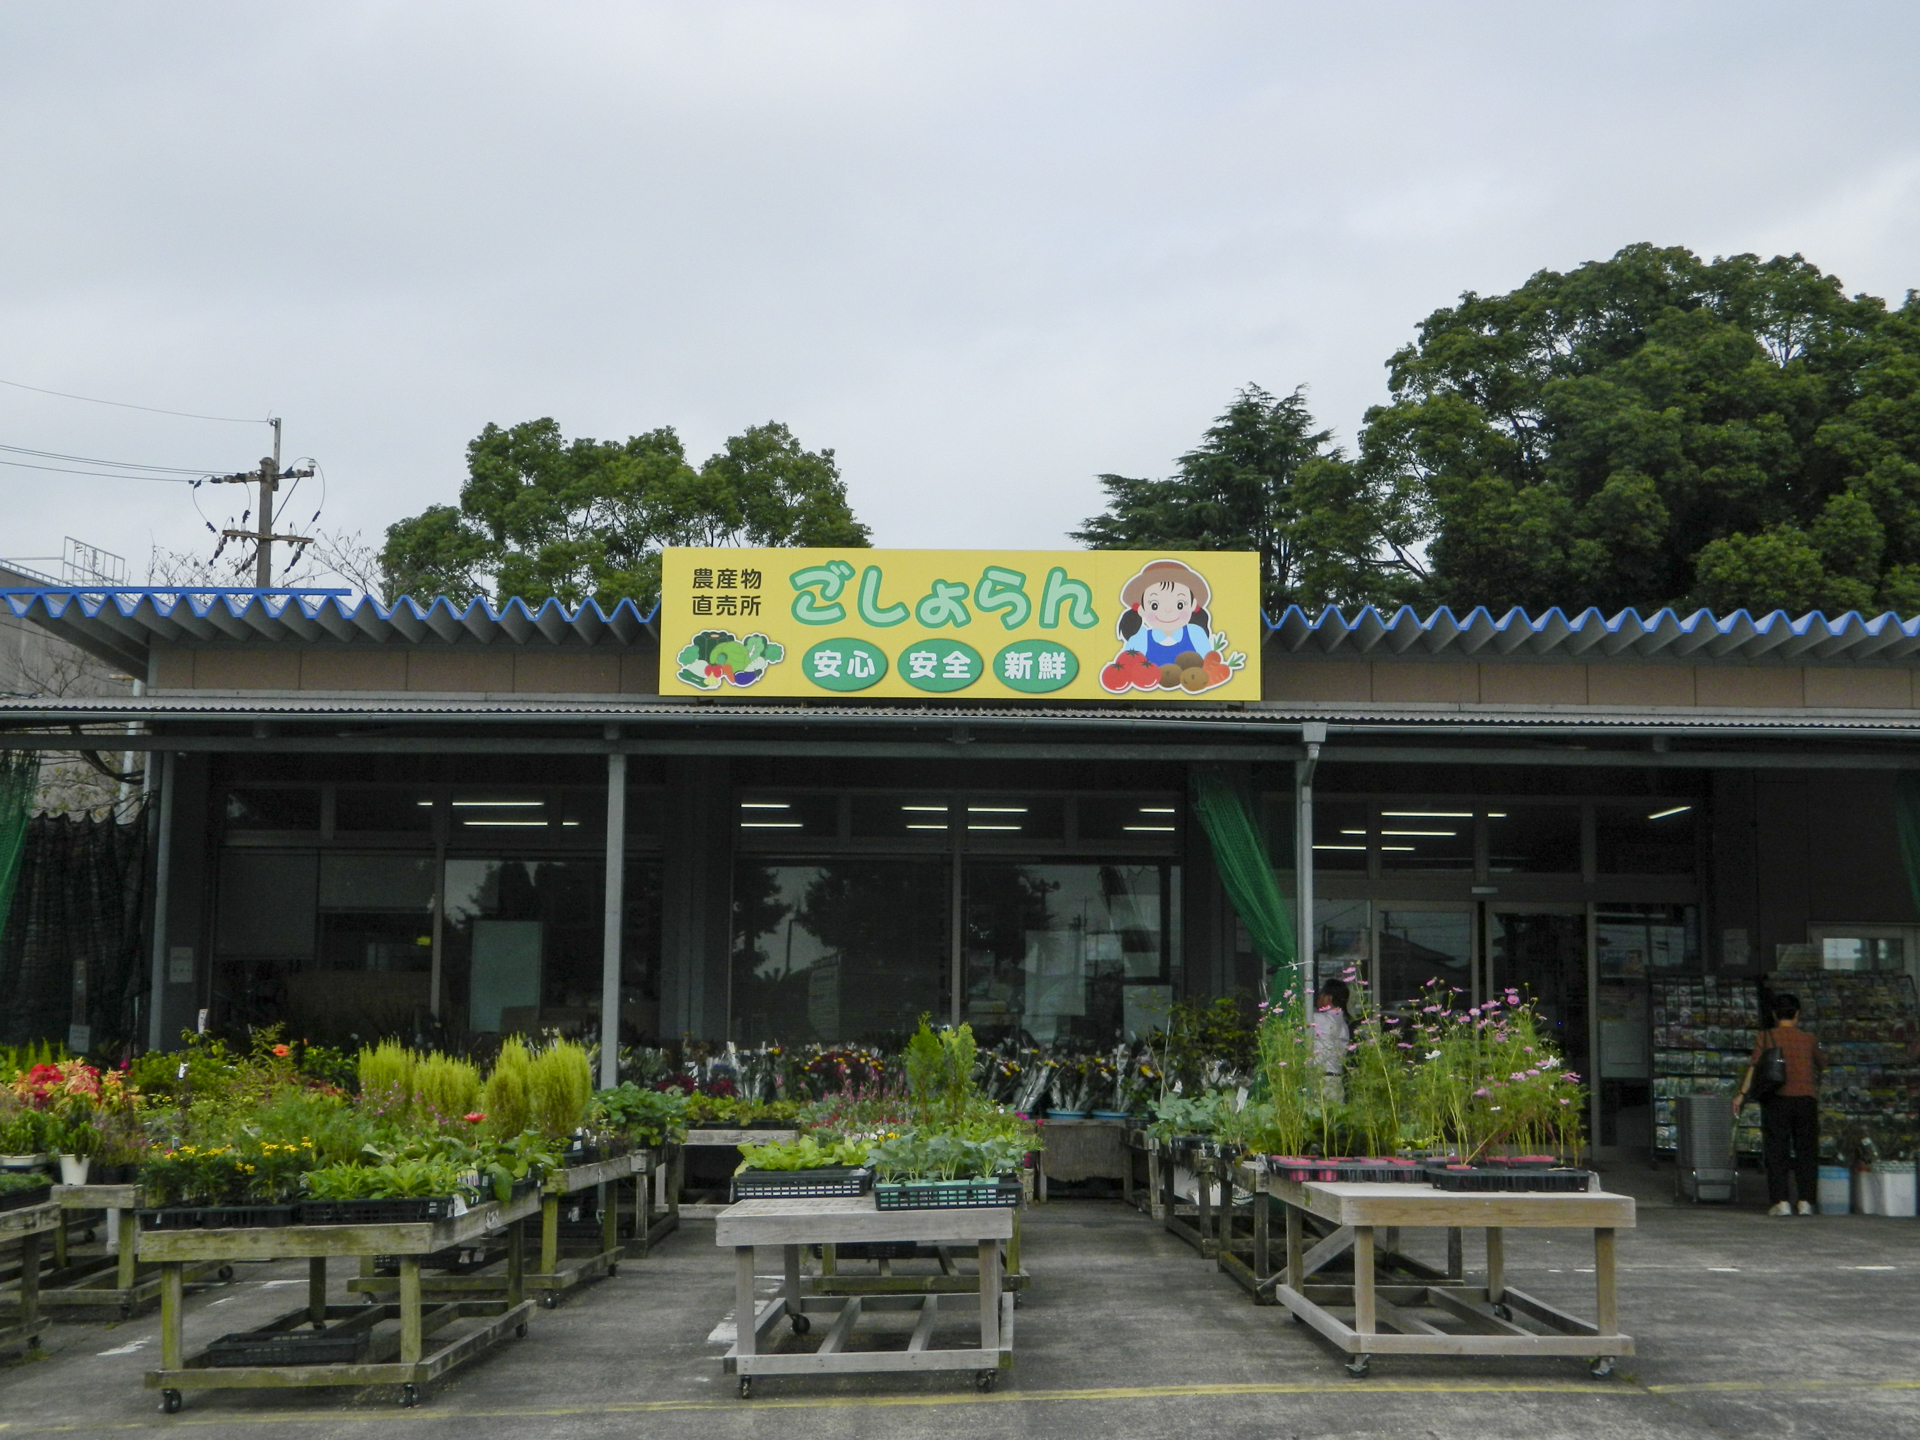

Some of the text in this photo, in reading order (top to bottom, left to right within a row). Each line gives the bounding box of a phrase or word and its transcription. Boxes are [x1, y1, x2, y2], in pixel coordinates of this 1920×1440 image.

[692, 568, 762, 589] 農産物
[692, 595, 761, 616] 直売所
[789, 560, 1099, 631] ごしょらん
[814, 650, 1066, 680] 安心 安全 新鮮
